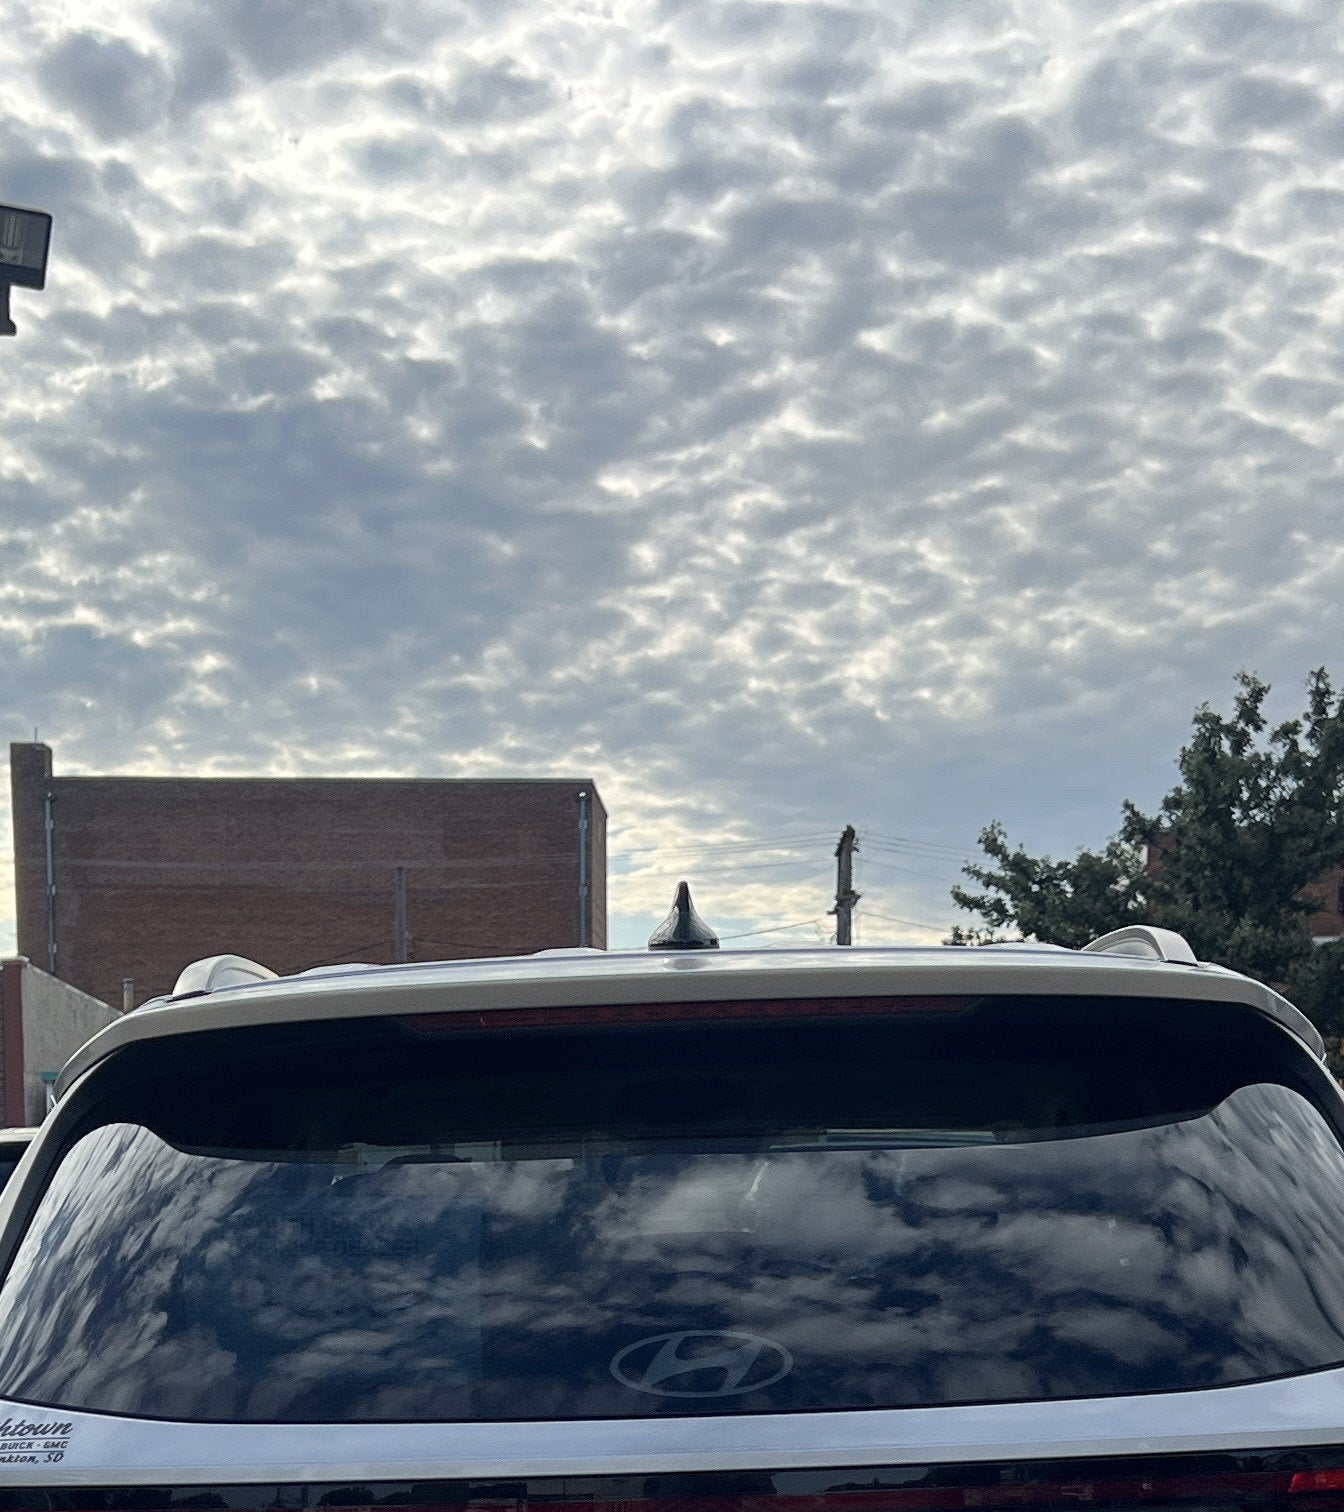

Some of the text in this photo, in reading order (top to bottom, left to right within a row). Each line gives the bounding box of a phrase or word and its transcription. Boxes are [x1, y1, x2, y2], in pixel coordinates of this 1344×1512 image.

[0, 1441, 34, 1451] BUICK
[43, 1440, 69, 1449] GMC
[43, 1451, 64, 1463] SD
